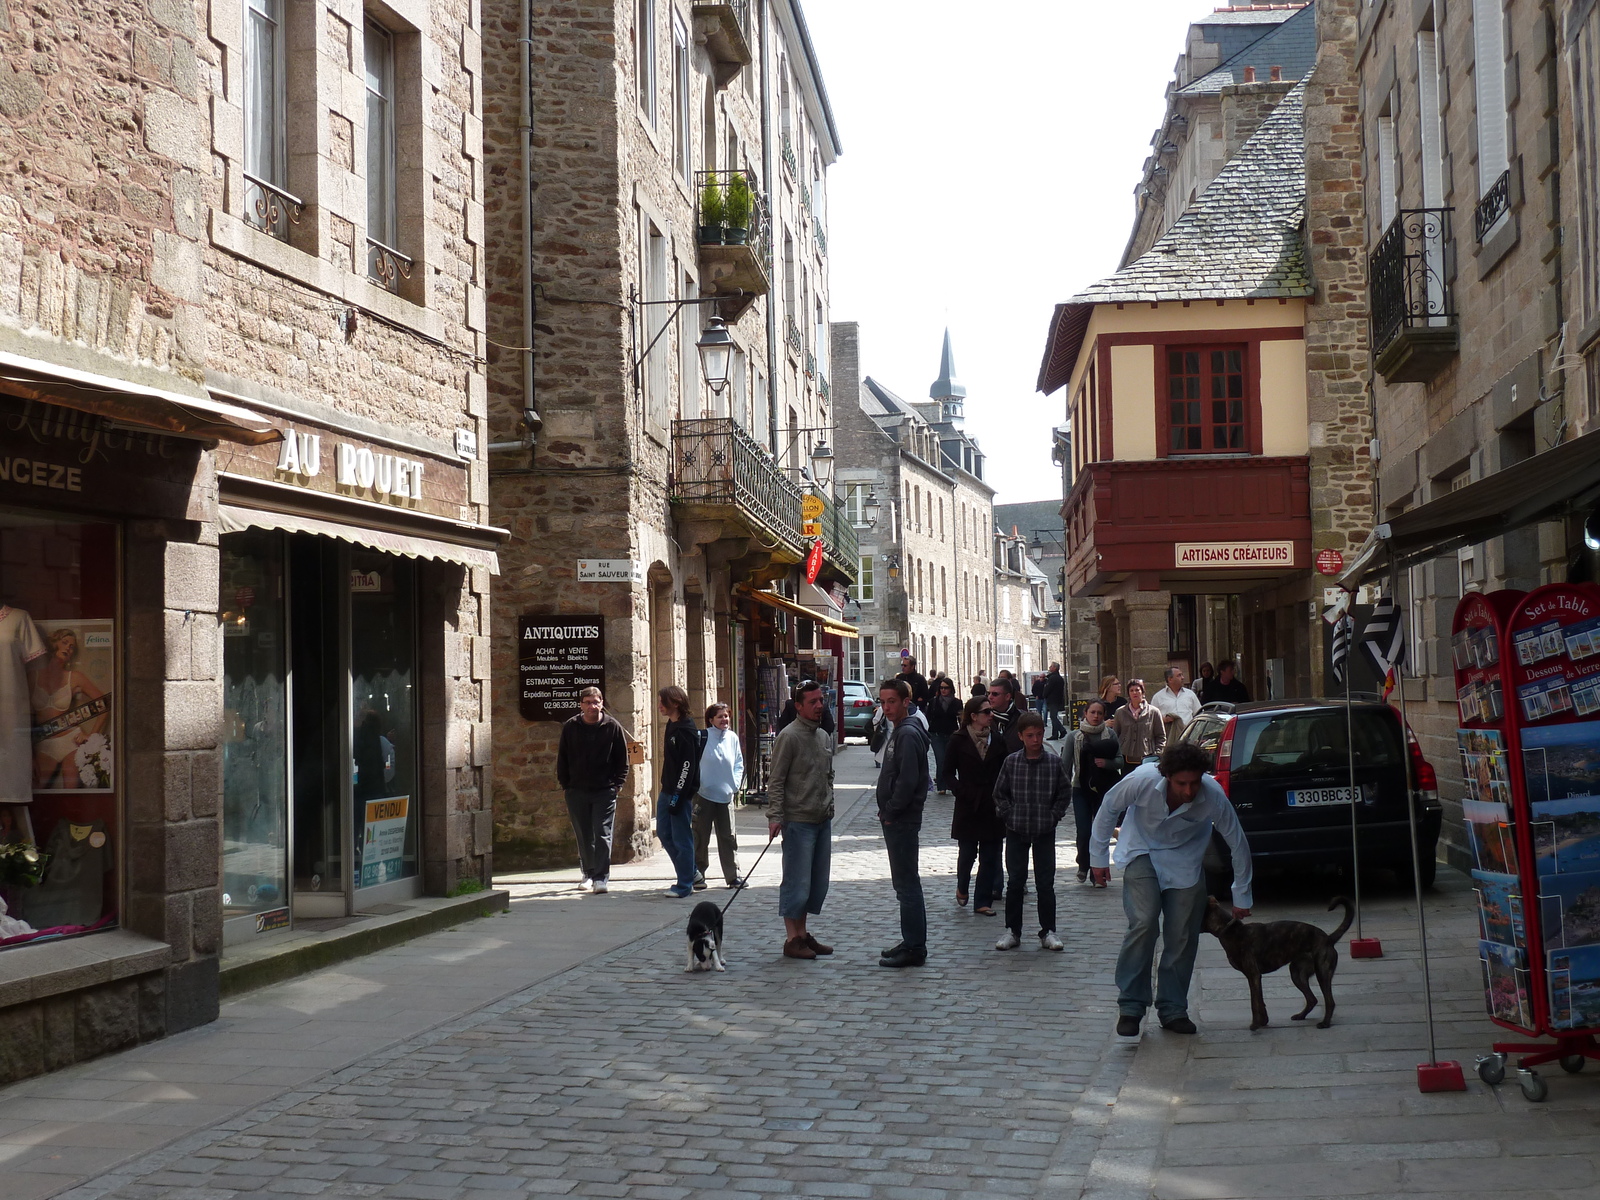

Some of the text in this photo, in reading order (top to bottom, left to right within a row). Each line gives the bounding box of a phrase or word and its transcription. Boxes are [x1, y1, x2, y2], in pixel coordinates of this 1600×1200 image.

[278, 428, 426, 500] AU ROUET
[1182, 545, 1288, 561] ARTISANS CRÉATEURS
[808, 546, 819, 579] TABAC
[1524, 595, 1589, 621] Set de Table
[86, 635, 110, 645] felina
[535, 647, 556, 655] ACHAT
[520, 664, 548, 672] Spécialité
[574, 664, 604, 672] Régionaux
[1526, 663, 1600, 680] Dessous de Verre
[526, 677, 600, 686] ESTIMATIONS Débarras
[523, 690, 551, 699] Expédition
[552, 690, 571, 698] France
[374, 801, 402, 819] VENDU
